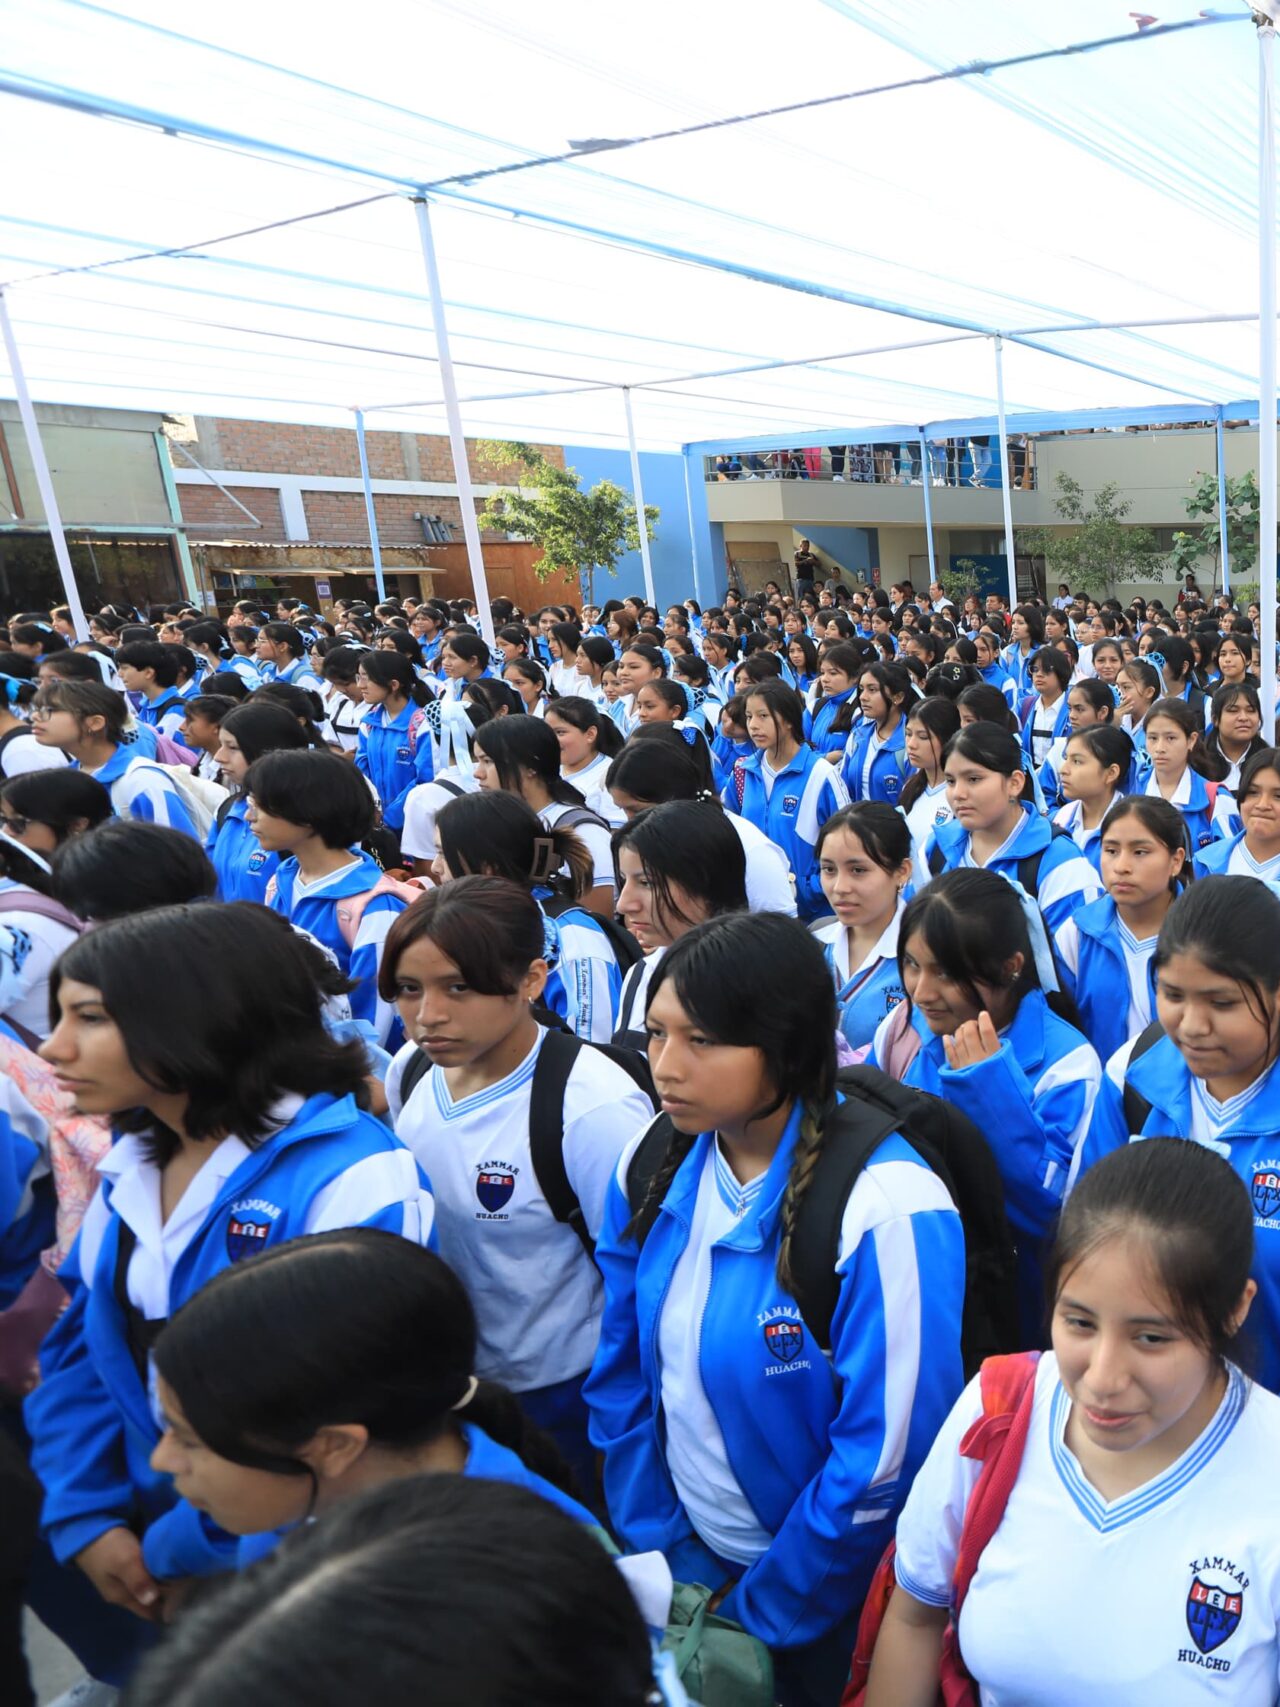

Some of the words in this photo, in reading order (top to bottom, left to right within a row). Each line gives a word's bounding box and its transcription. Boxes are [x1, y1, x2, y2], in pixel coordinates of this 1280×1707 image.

[756, 1306, 804, 1327] XAMMA
[1188, 1556, 1250, 1591] XAMMAR
[1177, 1649, 1231, 1672] HUACHO
